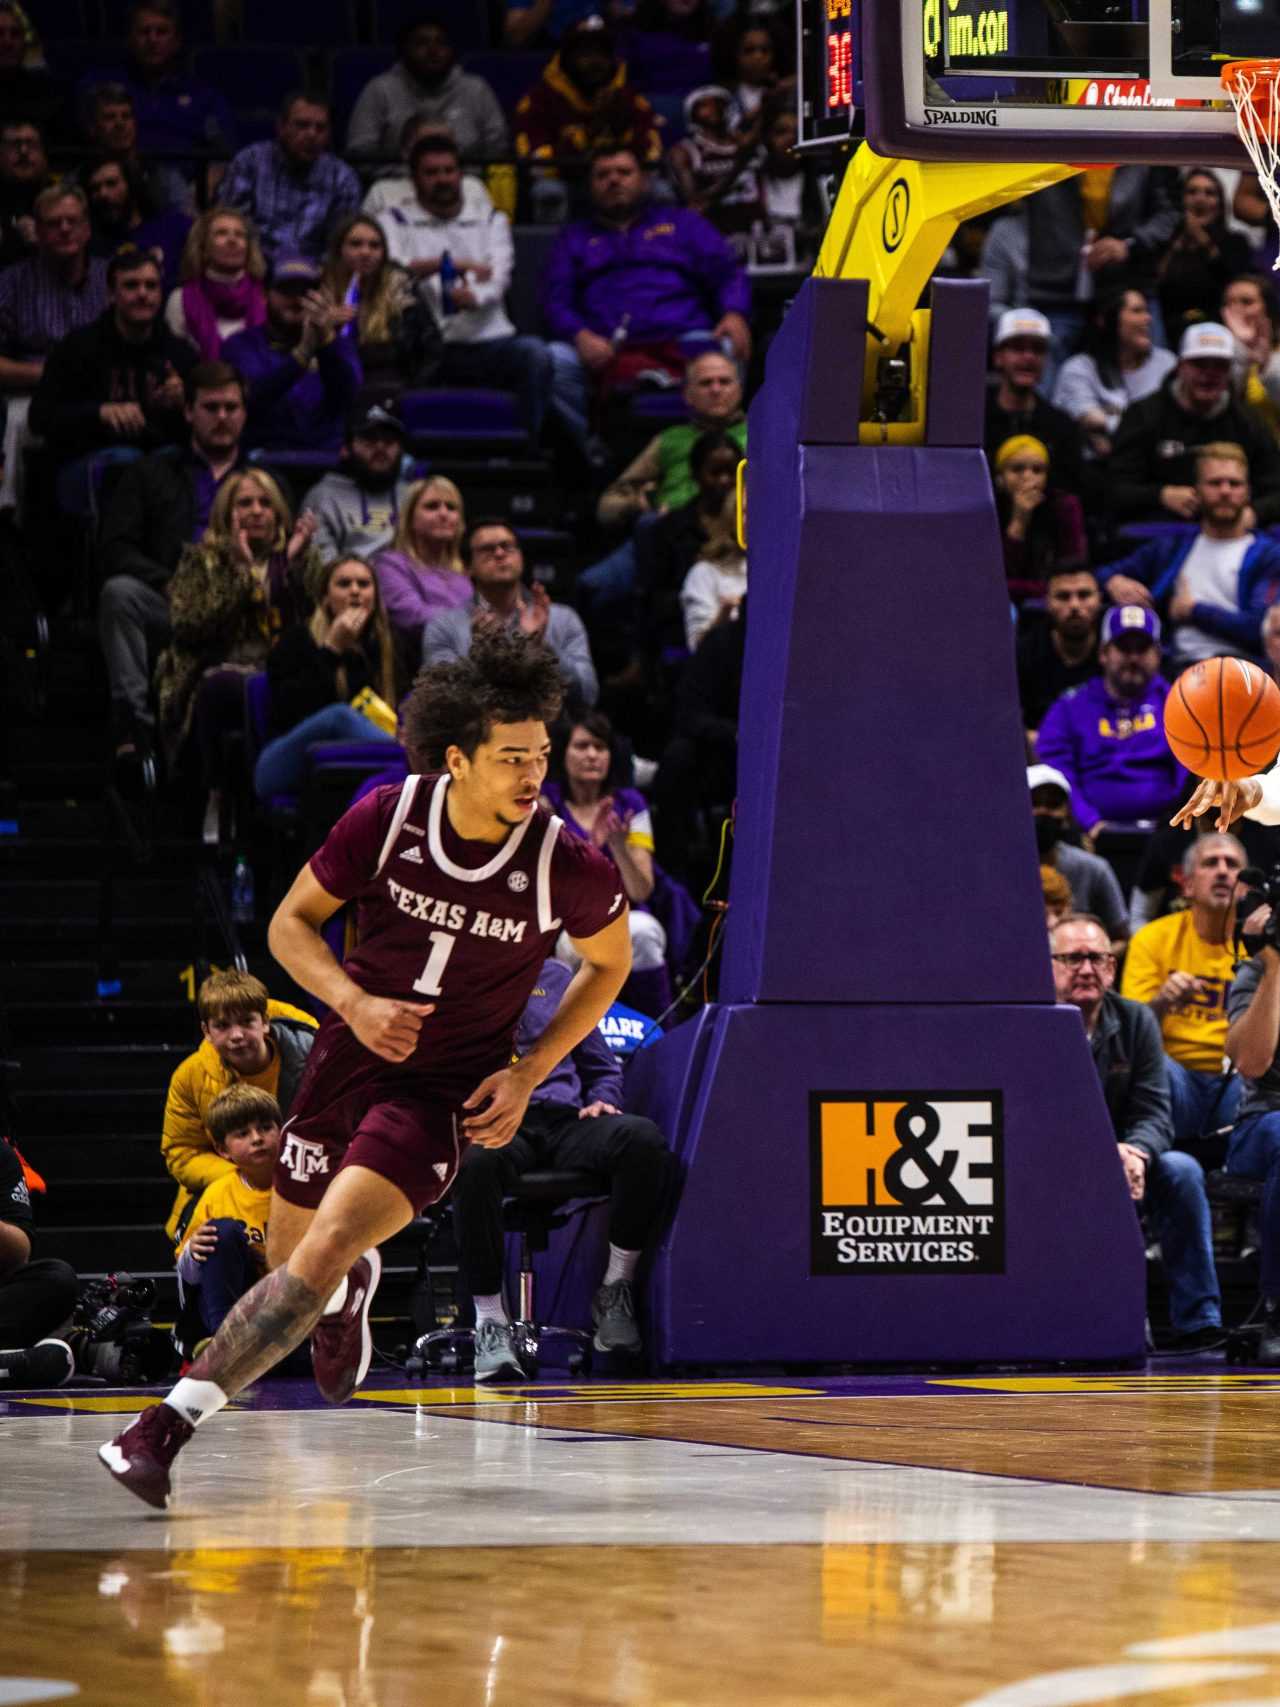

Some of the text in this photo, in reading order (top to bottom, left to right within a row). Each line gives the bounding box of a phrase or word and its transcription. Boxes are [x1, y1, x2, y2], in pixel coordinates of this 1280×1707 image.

[923, 109, 997, 126] SPALDING
[387, 877, 528, 943] TEXAS A&M
[412, 930, 456, 996] 1
[821, 1101, 994, 1207] H&E
[821, 1211, 994, 1237] EQUIPMENT
